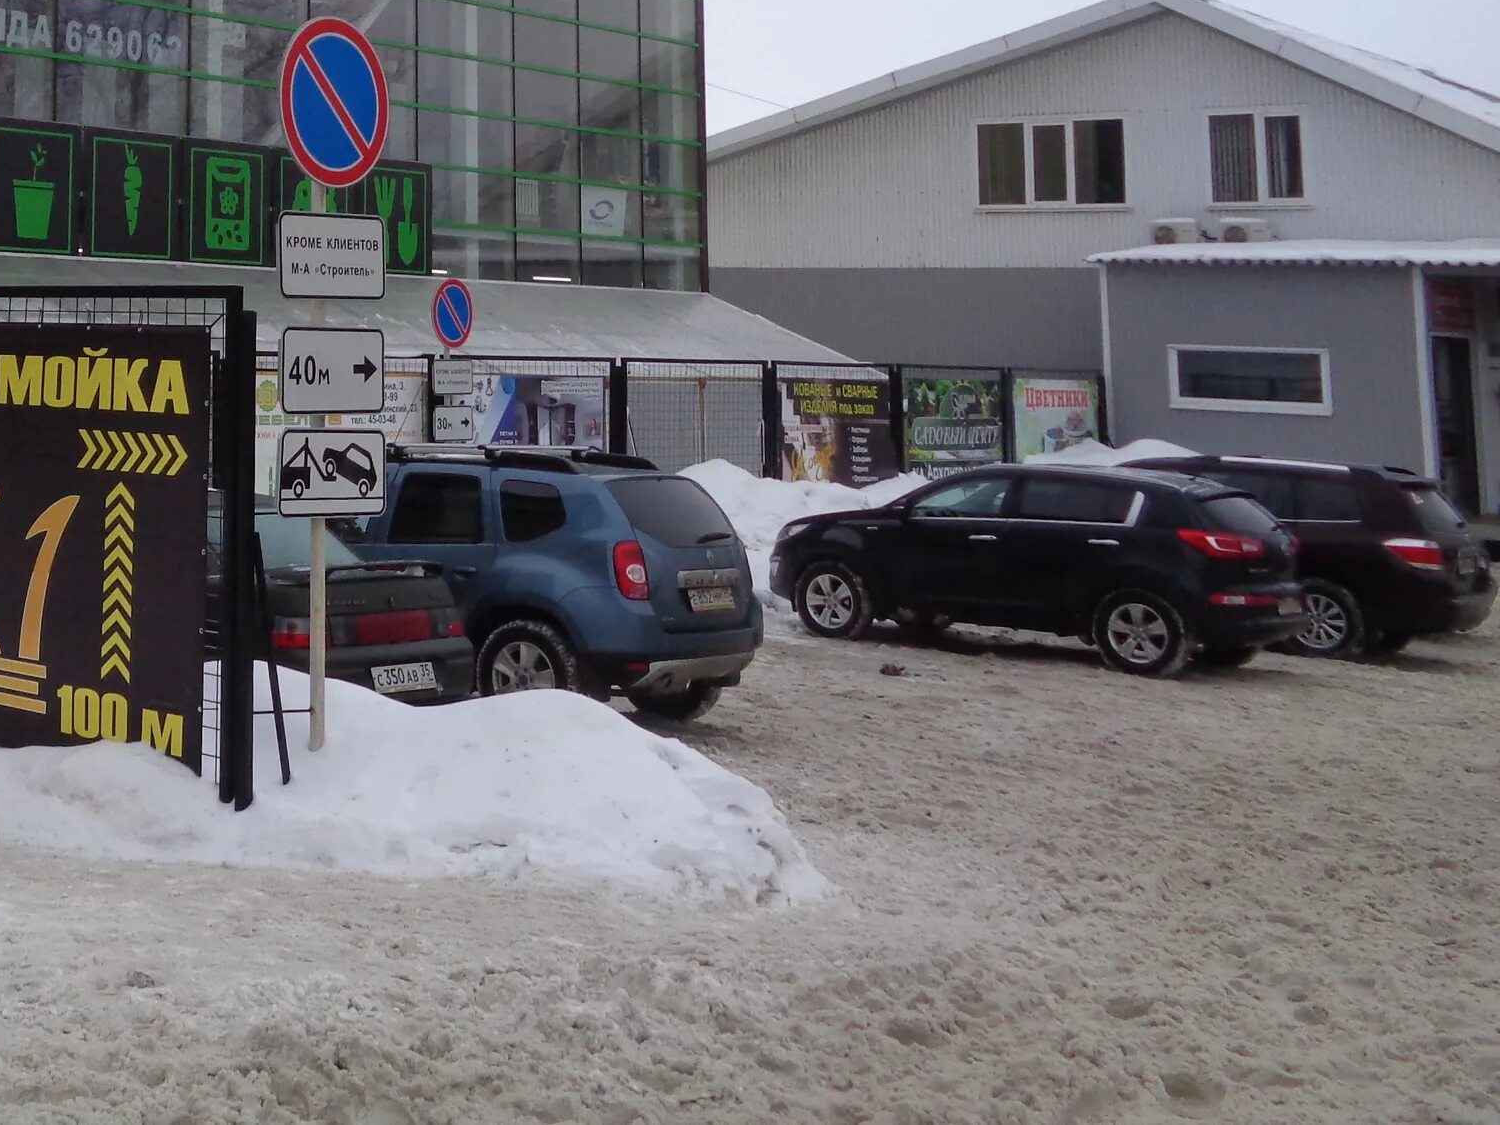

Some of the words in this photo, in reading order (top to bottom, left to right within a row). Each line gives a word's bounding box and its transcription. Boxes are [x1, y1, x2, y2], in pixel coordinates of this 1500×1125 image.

[286, 236, 322, 250] КРОМЕ
[326, 237, 379, 252] КЛИЕНТОВ
[291, 263, 310, 274] М-А
[842, 384, 878, 398] СВАРНЫЕ
[1026, 388, 1089, 411] ЦВЕТНИКИ
[57, 685, 128, 743] 100
